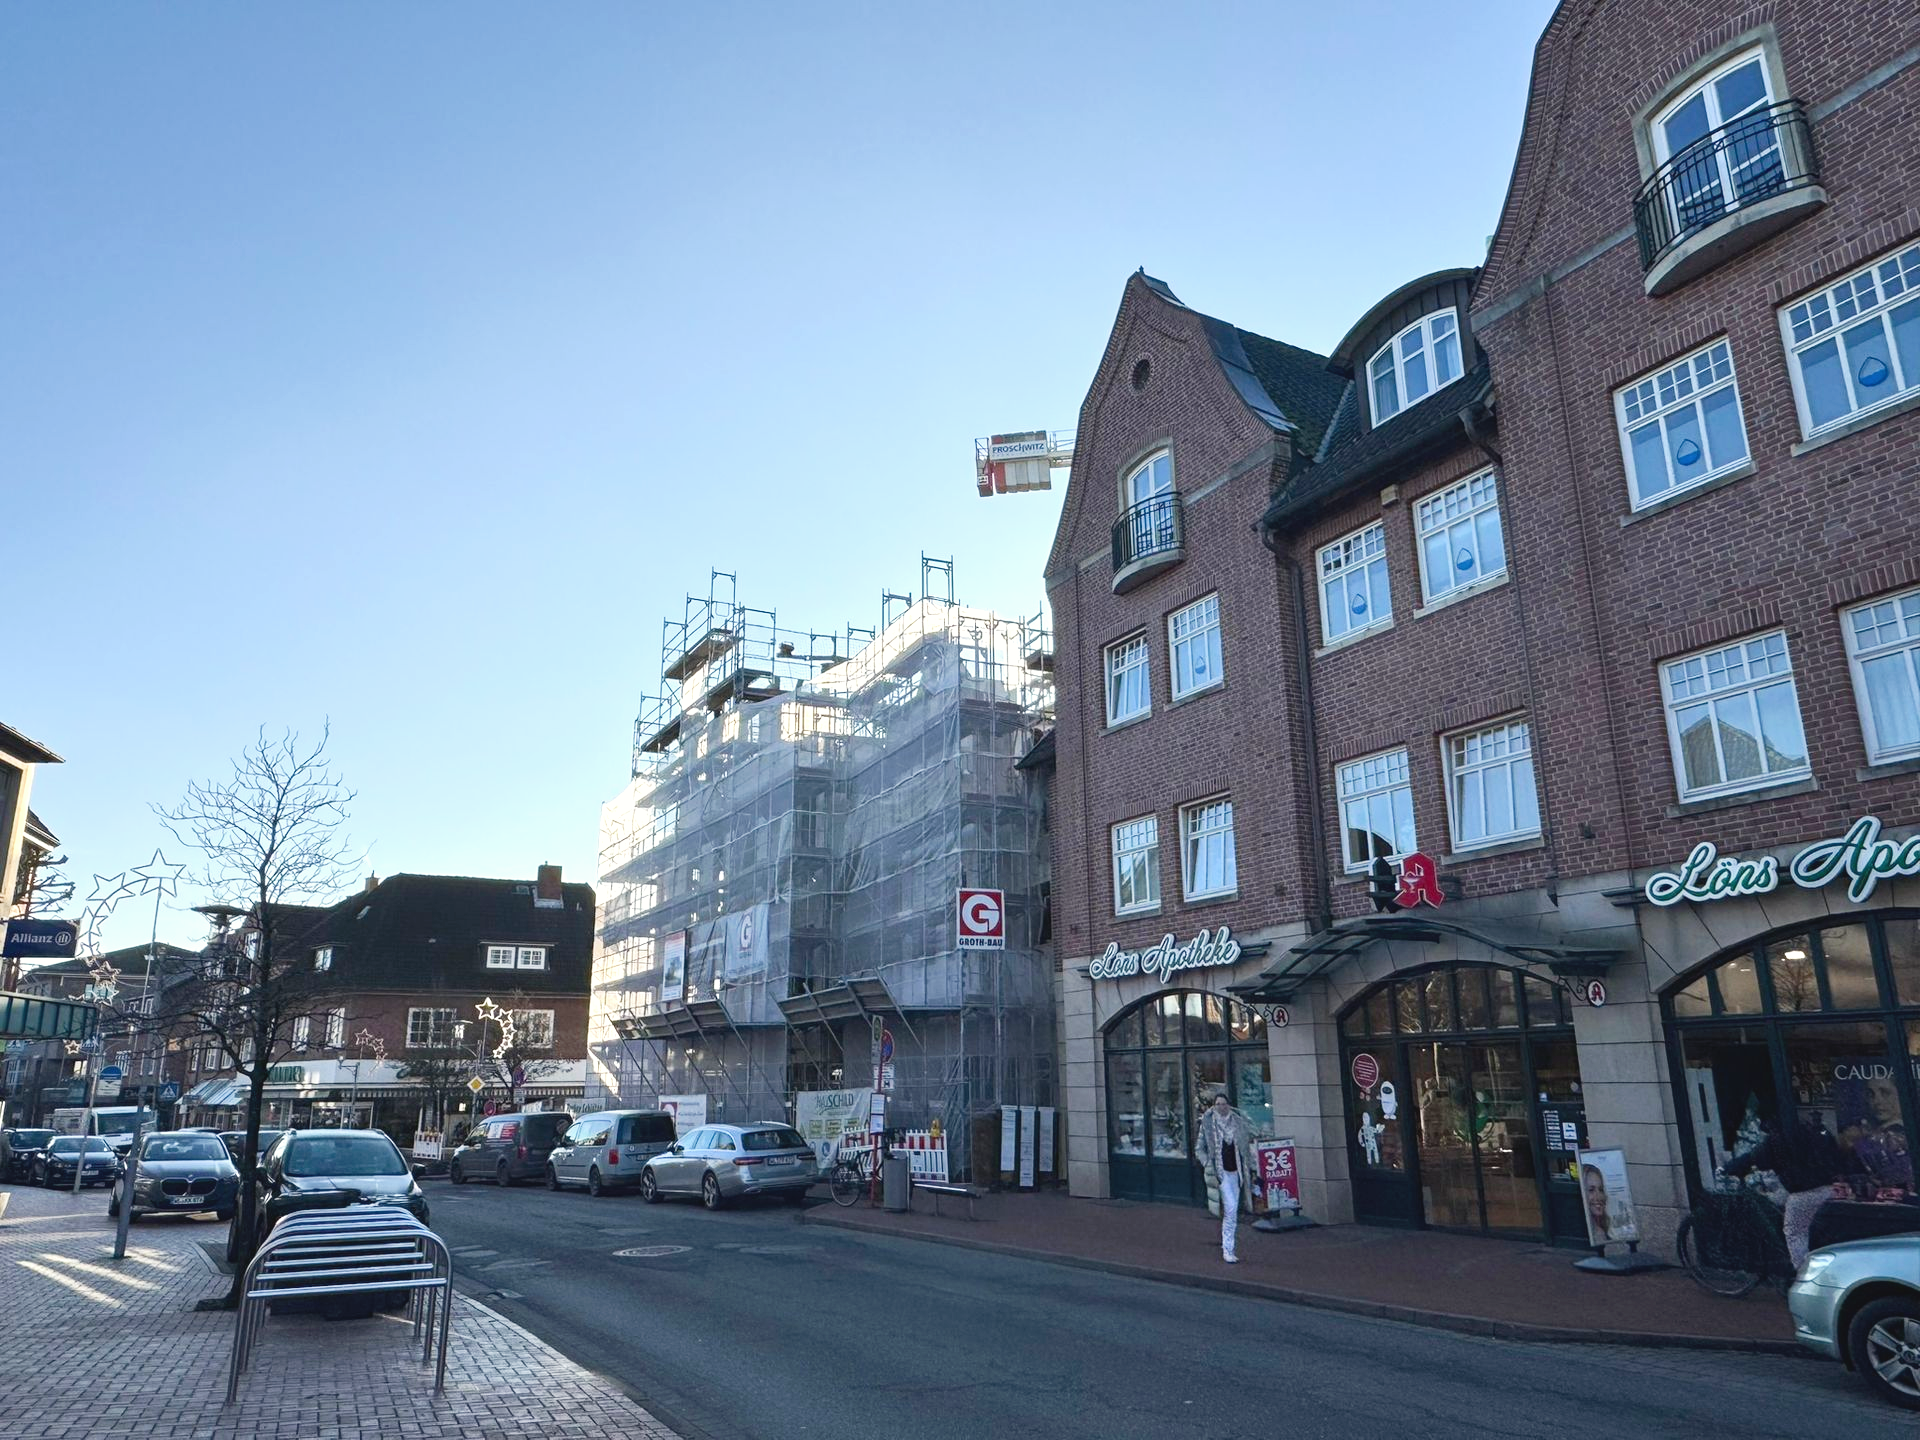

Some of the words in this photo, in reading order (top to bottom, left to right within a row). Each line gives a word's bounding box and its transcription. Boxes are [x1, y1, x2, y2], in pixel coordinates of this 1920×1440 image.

[992, 443, 1045, 453] PROSCHWITZ
[1647, 843, 1777, 905] Löns
[962, 894, 1000, 933] G
[11, 933, 53, 943] Allianz
[959, 938, 1003, 947] GROTH-BAU
[1090, 942, 1140, 979] Löns
[1141, 926, 1241, 983] Apotheke
